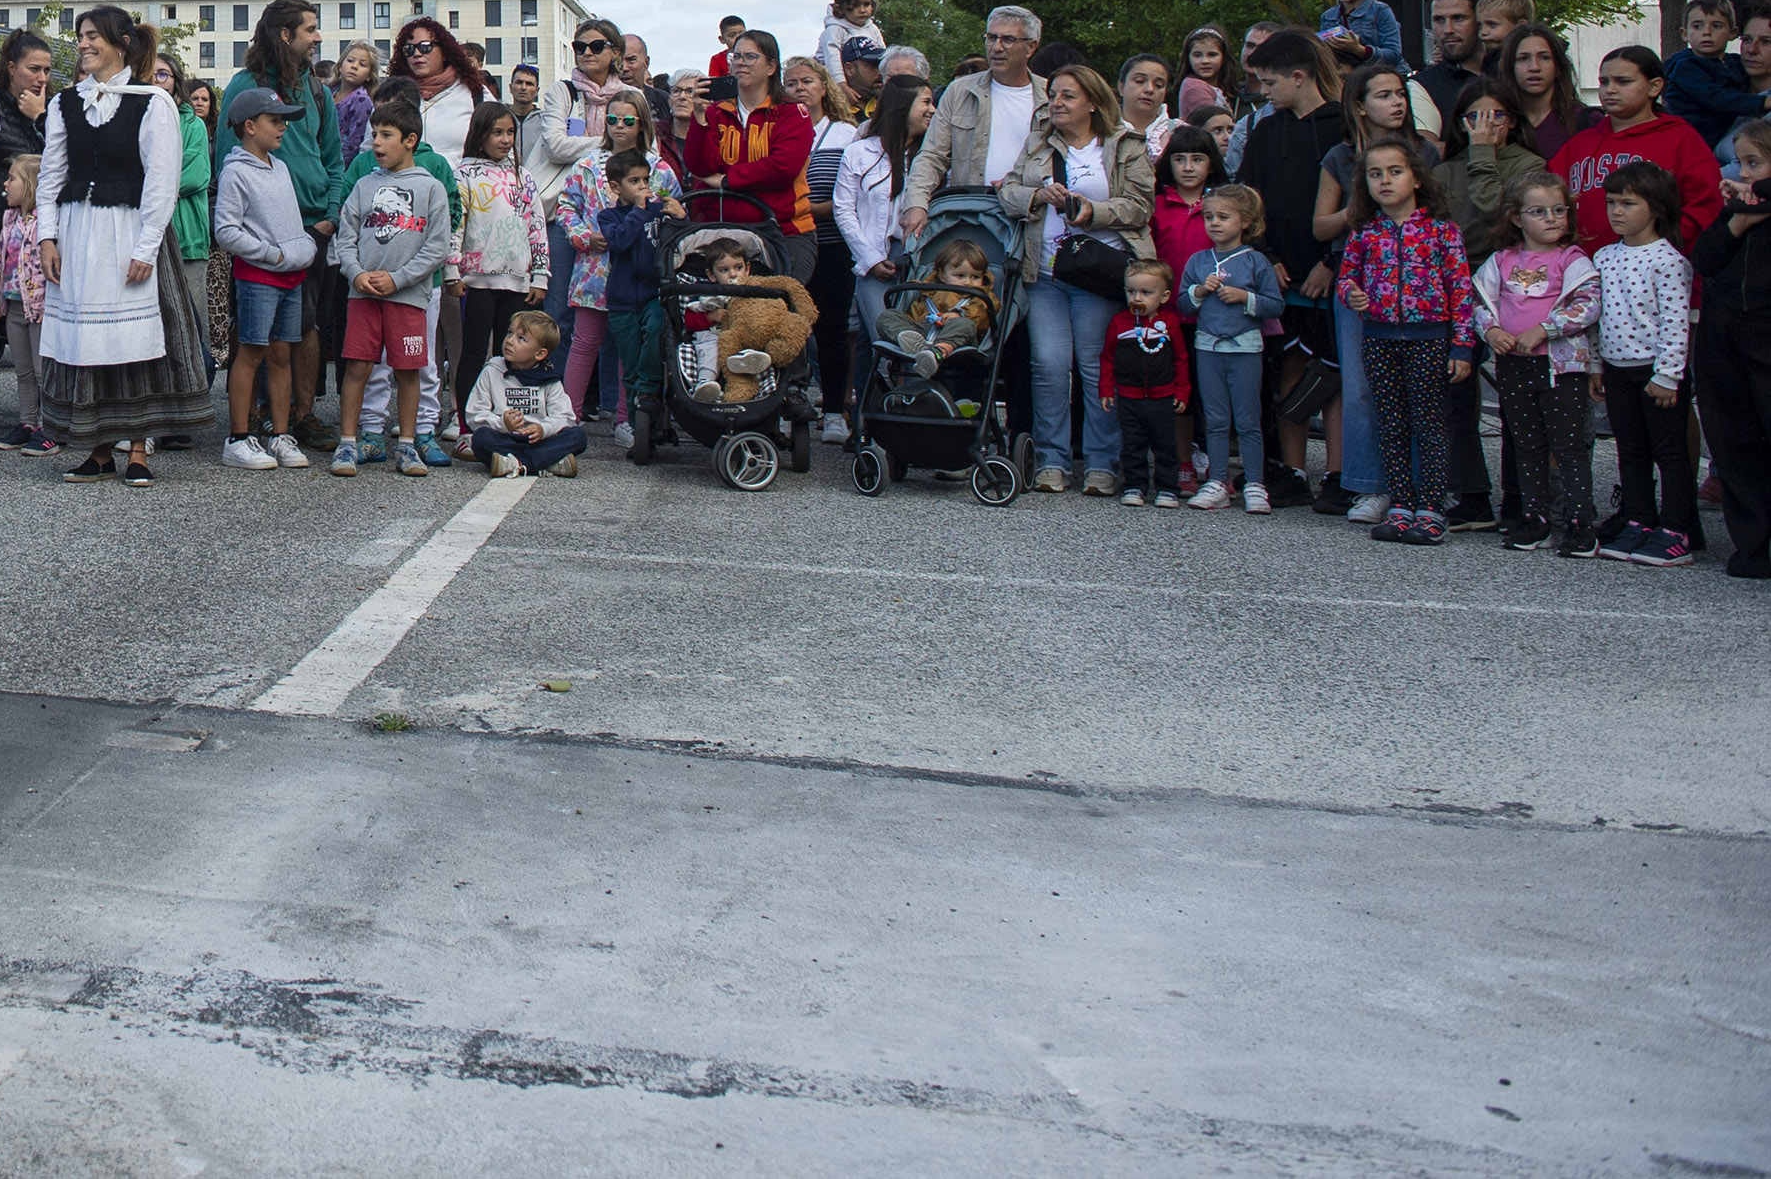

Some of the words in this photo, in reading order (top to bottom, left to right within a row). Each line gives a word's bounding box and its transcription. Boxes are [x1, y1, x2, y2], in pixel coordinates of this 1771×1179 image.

[1569, 153, 1651, 196] BOST
[507, 398, 529, 406] WANT
[531, 398, 539, 406] IT
